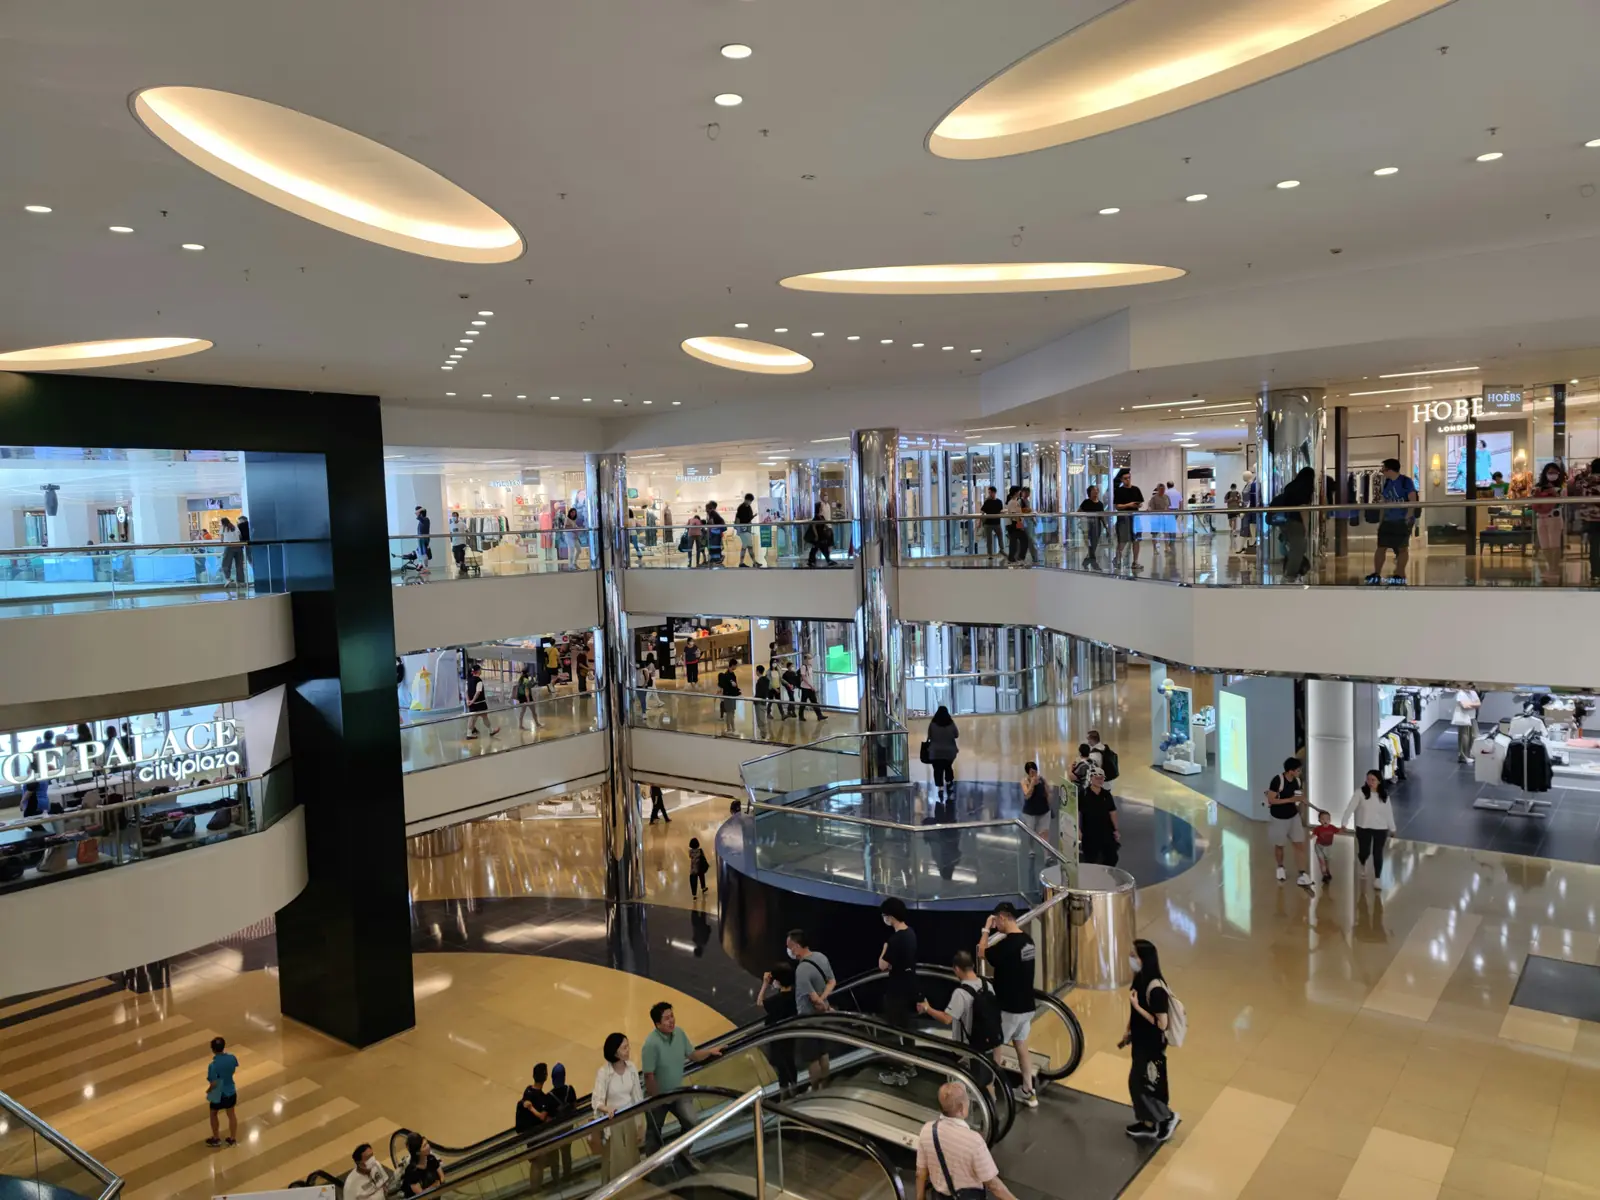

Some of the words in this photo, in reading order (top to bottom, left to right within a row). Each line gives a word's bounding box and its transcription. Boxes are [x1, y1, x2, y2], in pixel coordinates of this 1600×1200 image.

[1487, 393, 1521, 402] HOBBS
[1412, 397, 1485, 423] HOBB
[1437, 423, 1476, 433] LONDON
[931, 438, 937, 450] 2
[2, 746, 66, 785] CE
[75, 718, 239, 774] PALACE
[138, 750, 240, 782] cityplaza
